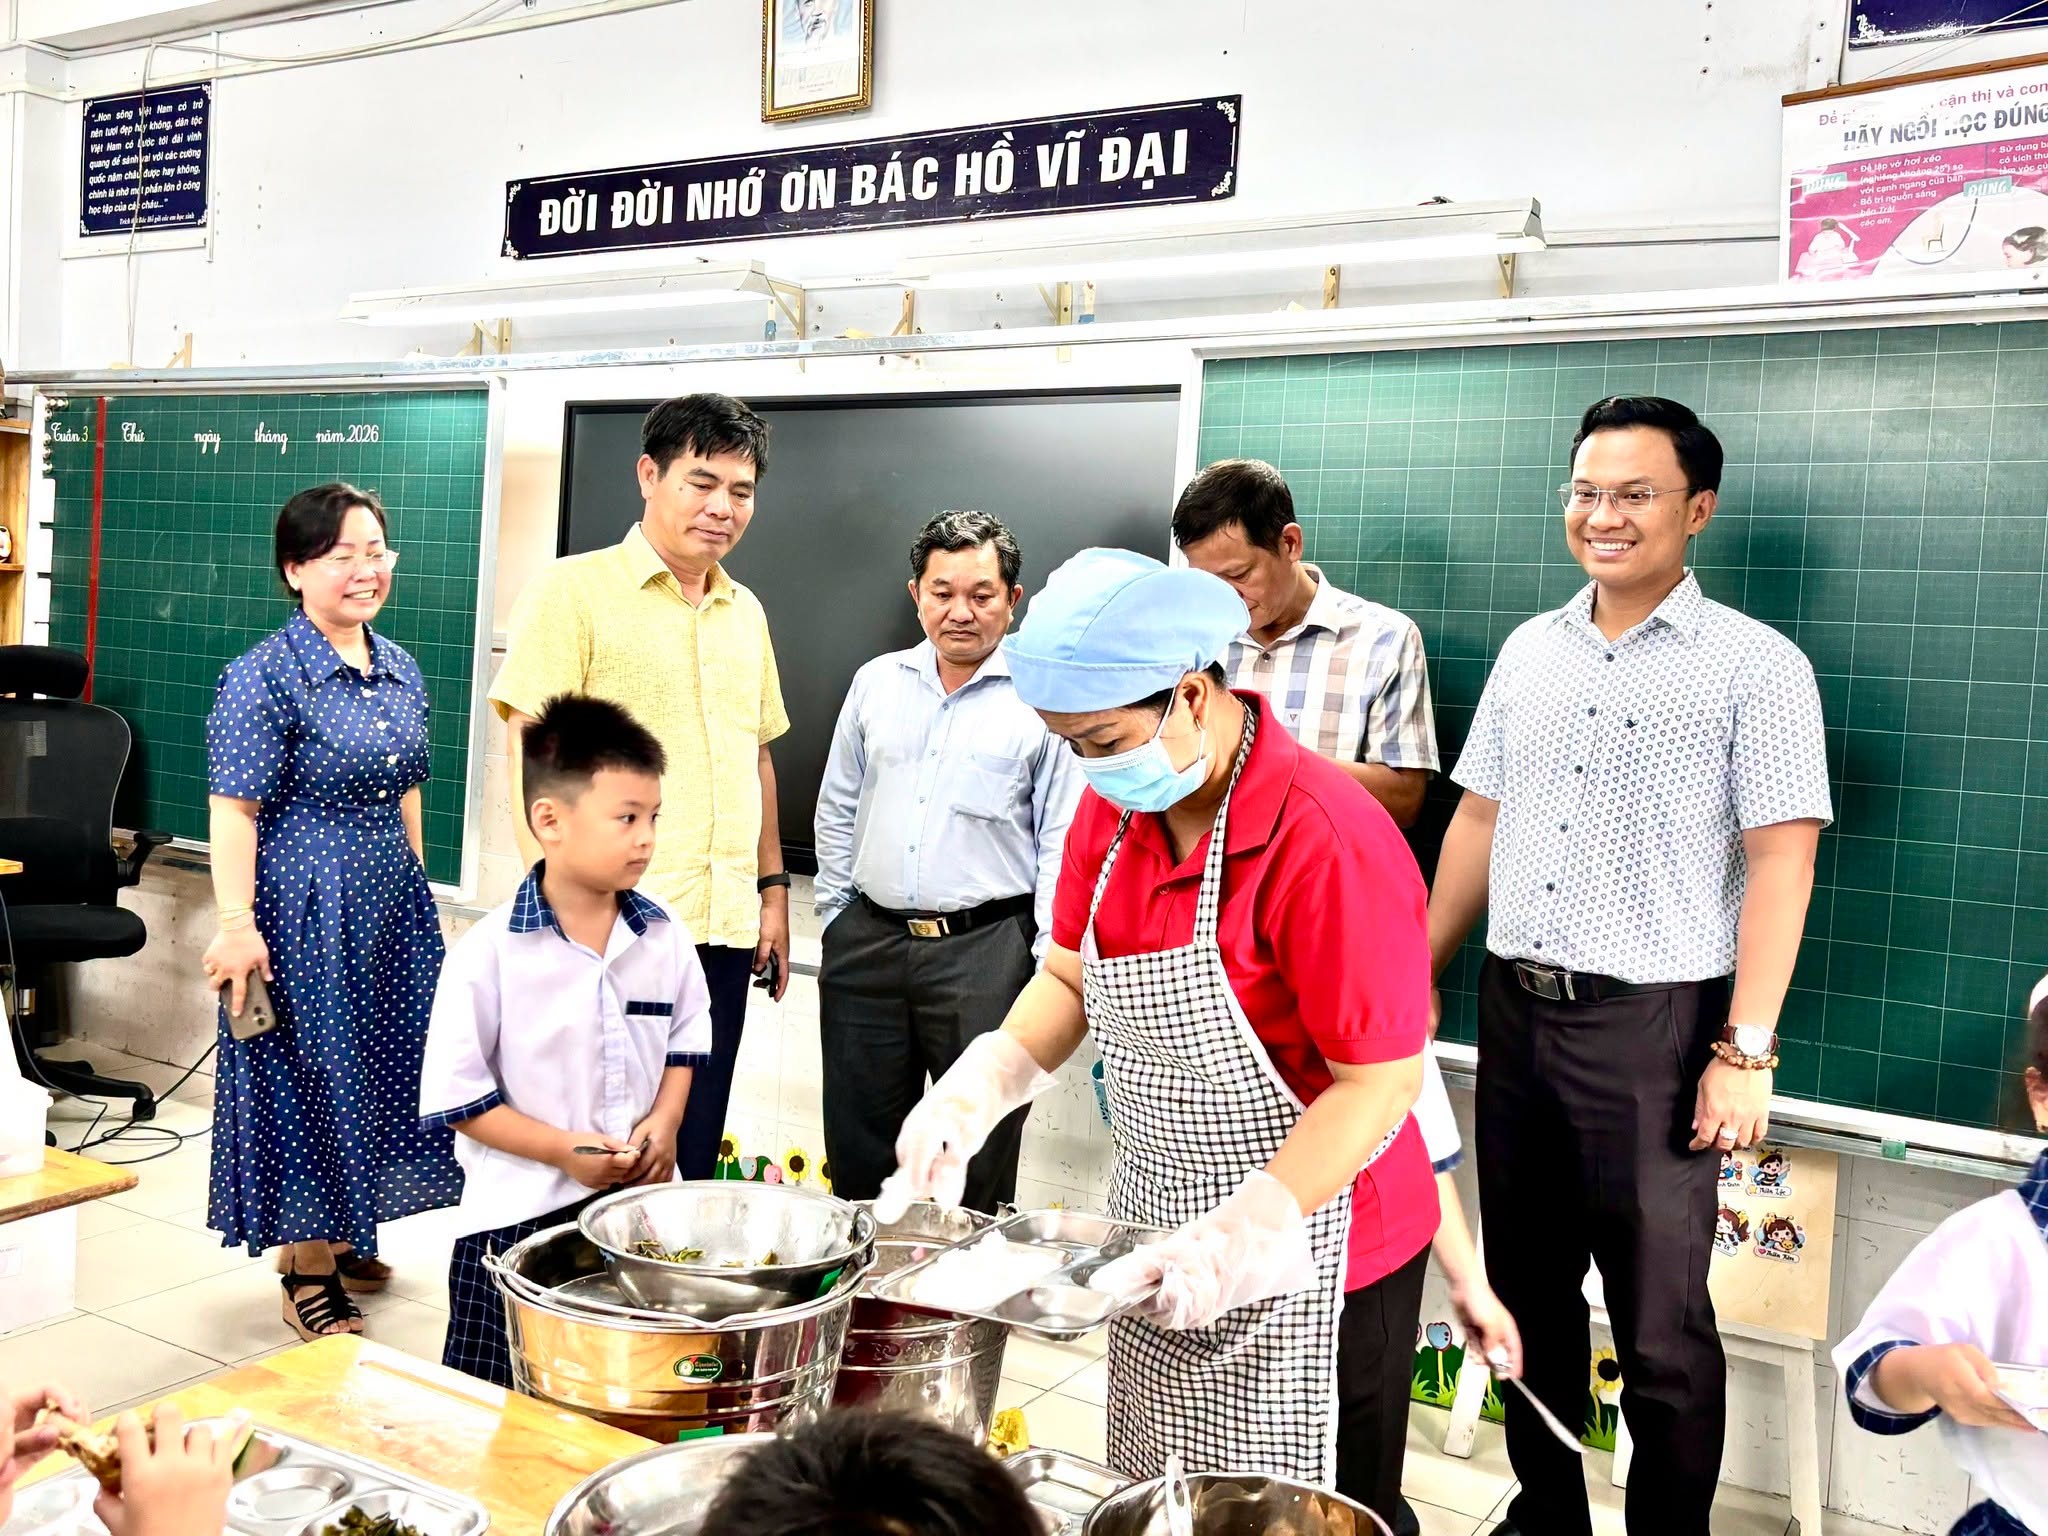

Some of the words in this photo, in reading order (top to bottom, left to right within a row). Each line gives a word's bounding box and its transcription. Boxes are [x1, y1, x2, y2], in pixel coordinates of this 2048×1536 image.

[1972, 88, 1992, 104] thị
[1996, 85, 2014, 98] và
[116, 110, 134, 120] sông
[138, 106, 152, 117] Vệt
[156, 104, 173, 114] Nam
[178, 102, 187, 112] có
[90, 143, 104, 154] Việt
[106, 142, 122, 152] Nam
[125, 140, 134, 150] có
[2015, 143, 2038, 152] dụng
[89, 158, 110, 170] quang
[164, 150, 178, 160] các
[162, 166, 176, 177] hay
[182, 181, 200, 192] công
[538, 188, 598, 236] ĐỜI
[610, 179, 674, 229] ĐỜI
[686, 166, 766, 222] NHỚ
[780, 165, 838, 213] ƠN
[850, 150, 940, 207] BÁC
[954, 132, 1016, 197] HỒ
[1036, 128, 1086, 189] VĨ
[1098, 128, 1188, 190] ĐẠI
[1900, 180, 1927, 190] ngang
[88, 206, 101, 216] học
[114, 202, 127, 212] của
[82, 425, 88, 442] 3
[122, 422, 146, 442] Thứ
[194, 428, 221, 454] ngày
[254, 422, 288, 454] tháng
[316, 427, 346, 443] năm
[346, 424, 380, 443] 2026
